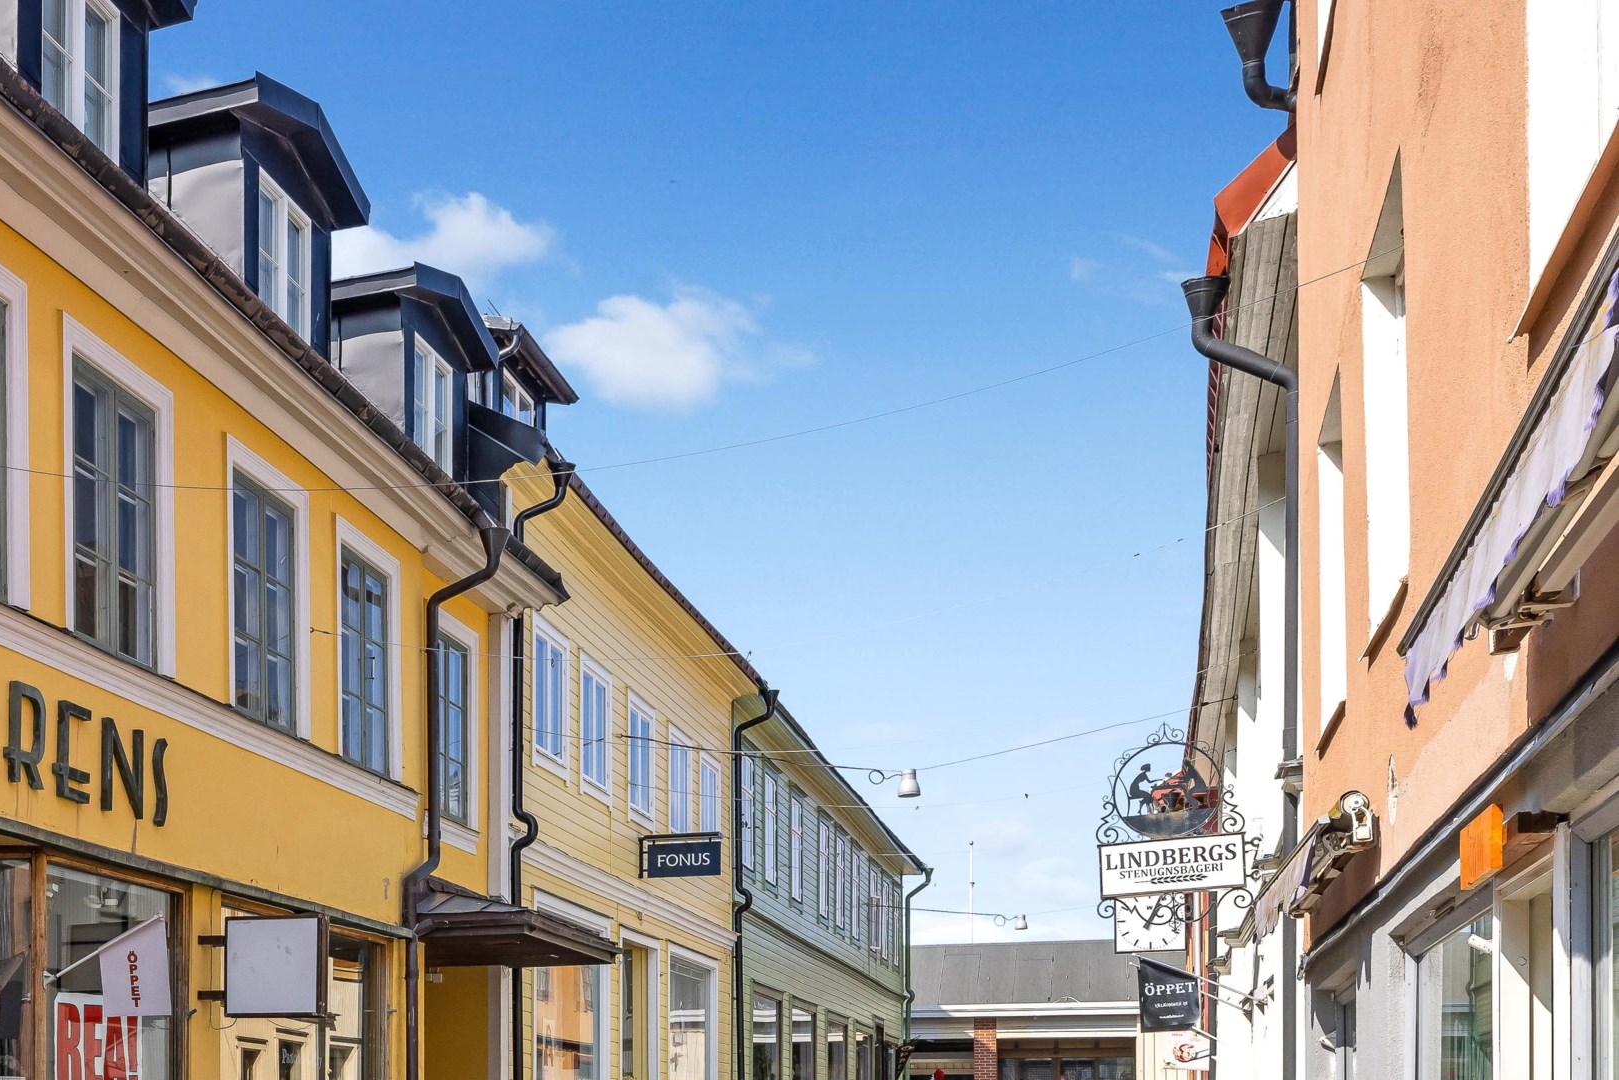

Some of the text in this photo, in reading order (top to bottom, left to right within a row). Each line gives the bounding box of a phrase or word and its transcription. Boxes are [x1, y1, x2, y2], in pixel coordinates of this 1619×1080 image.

[657, 852, 710, 867] FONUS
[1105, 843, 1237, 871] LINDBERGS
[1119, 862, 1223, 880] STENUGNSBAGERI
[127, 951, 141, 1007] ÖPPET
[1144, 982, 1196, 996] ÖPPET
